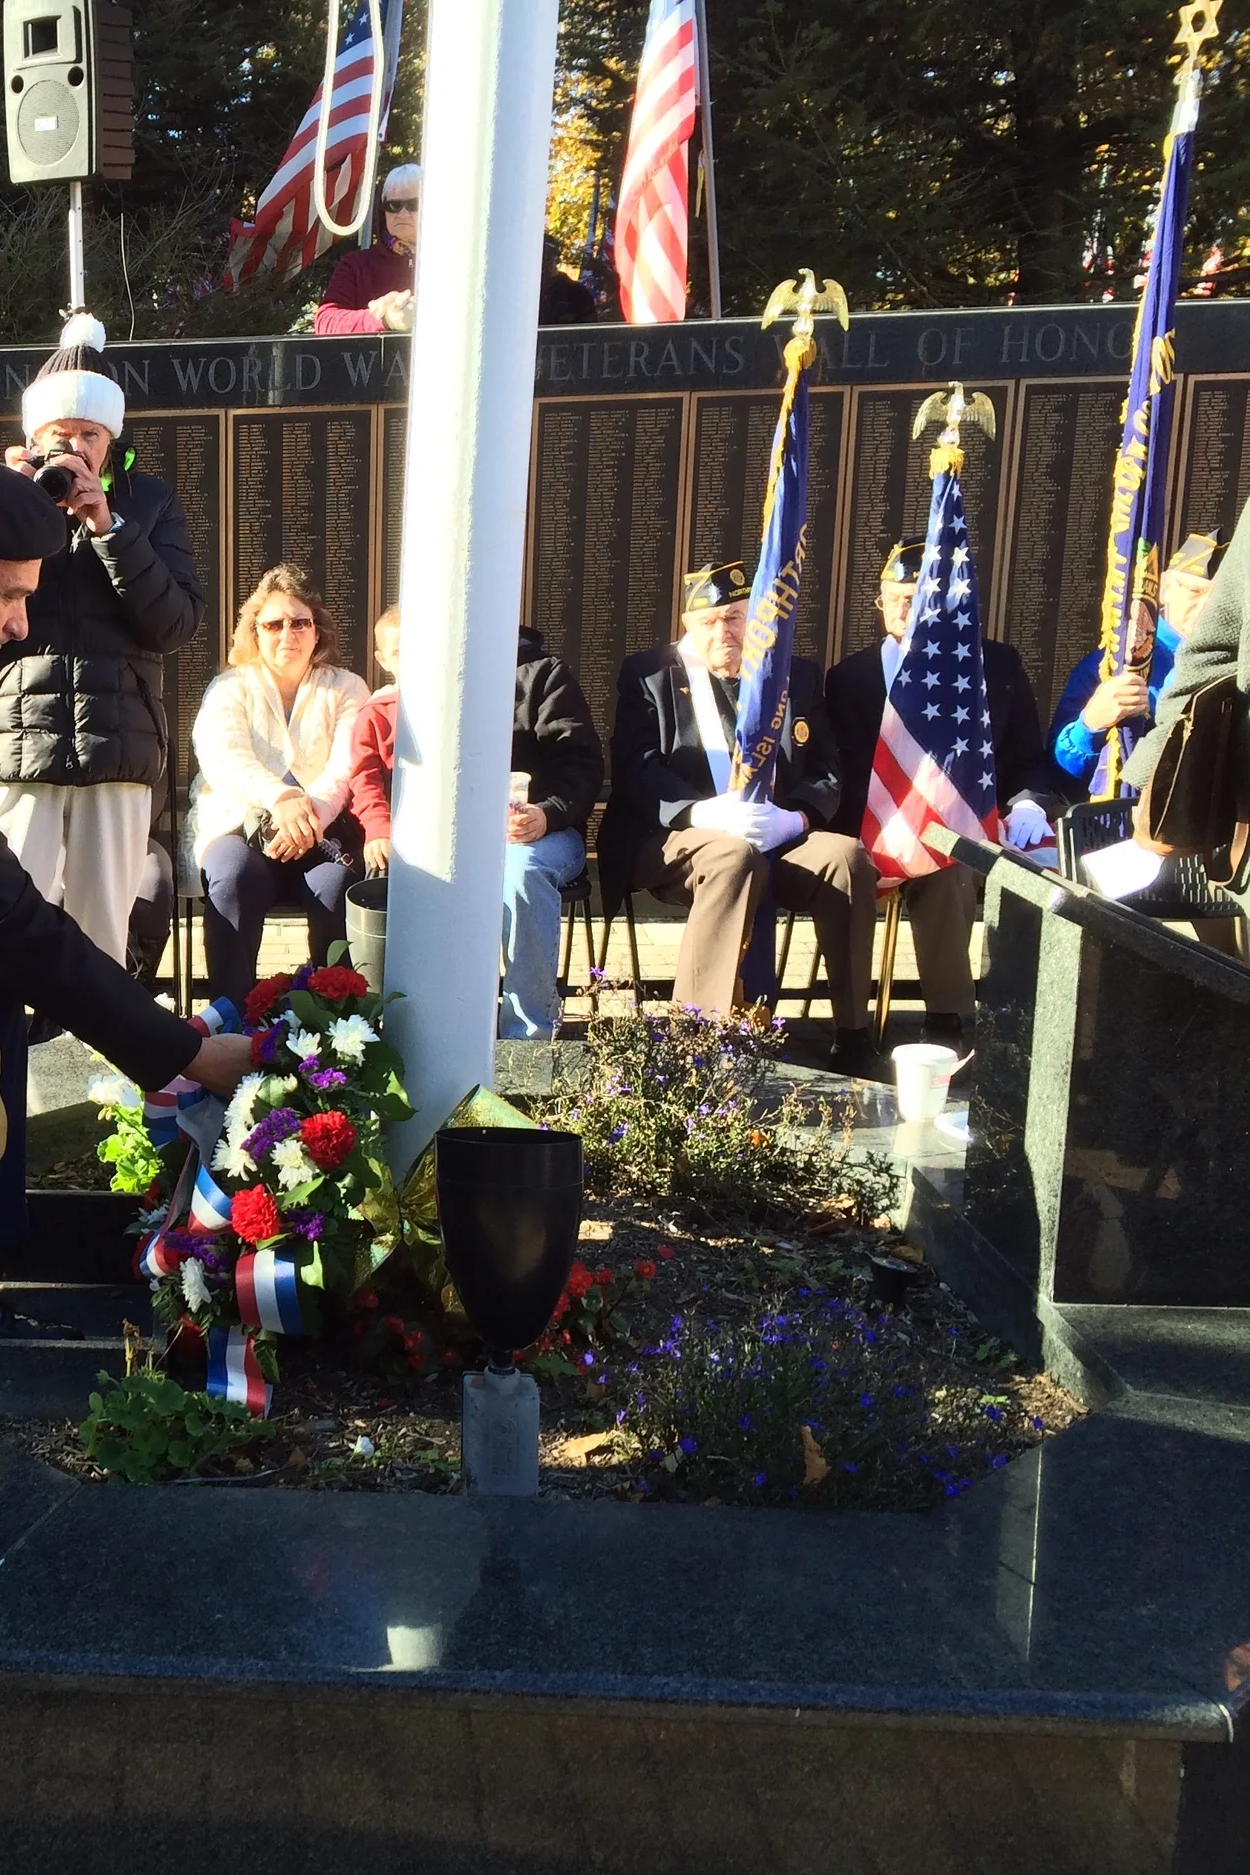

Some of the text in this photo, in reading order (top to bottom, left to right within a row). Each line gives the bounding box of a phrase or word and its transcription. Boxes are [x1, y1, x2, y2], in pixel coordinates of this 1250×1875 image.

[170, 353, 322, 395] WORLD
[340, 349, 410, 390] WA
[537, 335, 745, 381] ETERANS
[917, 327, 975, 367] OF
[1000, 320, 1136, 363] HONO
